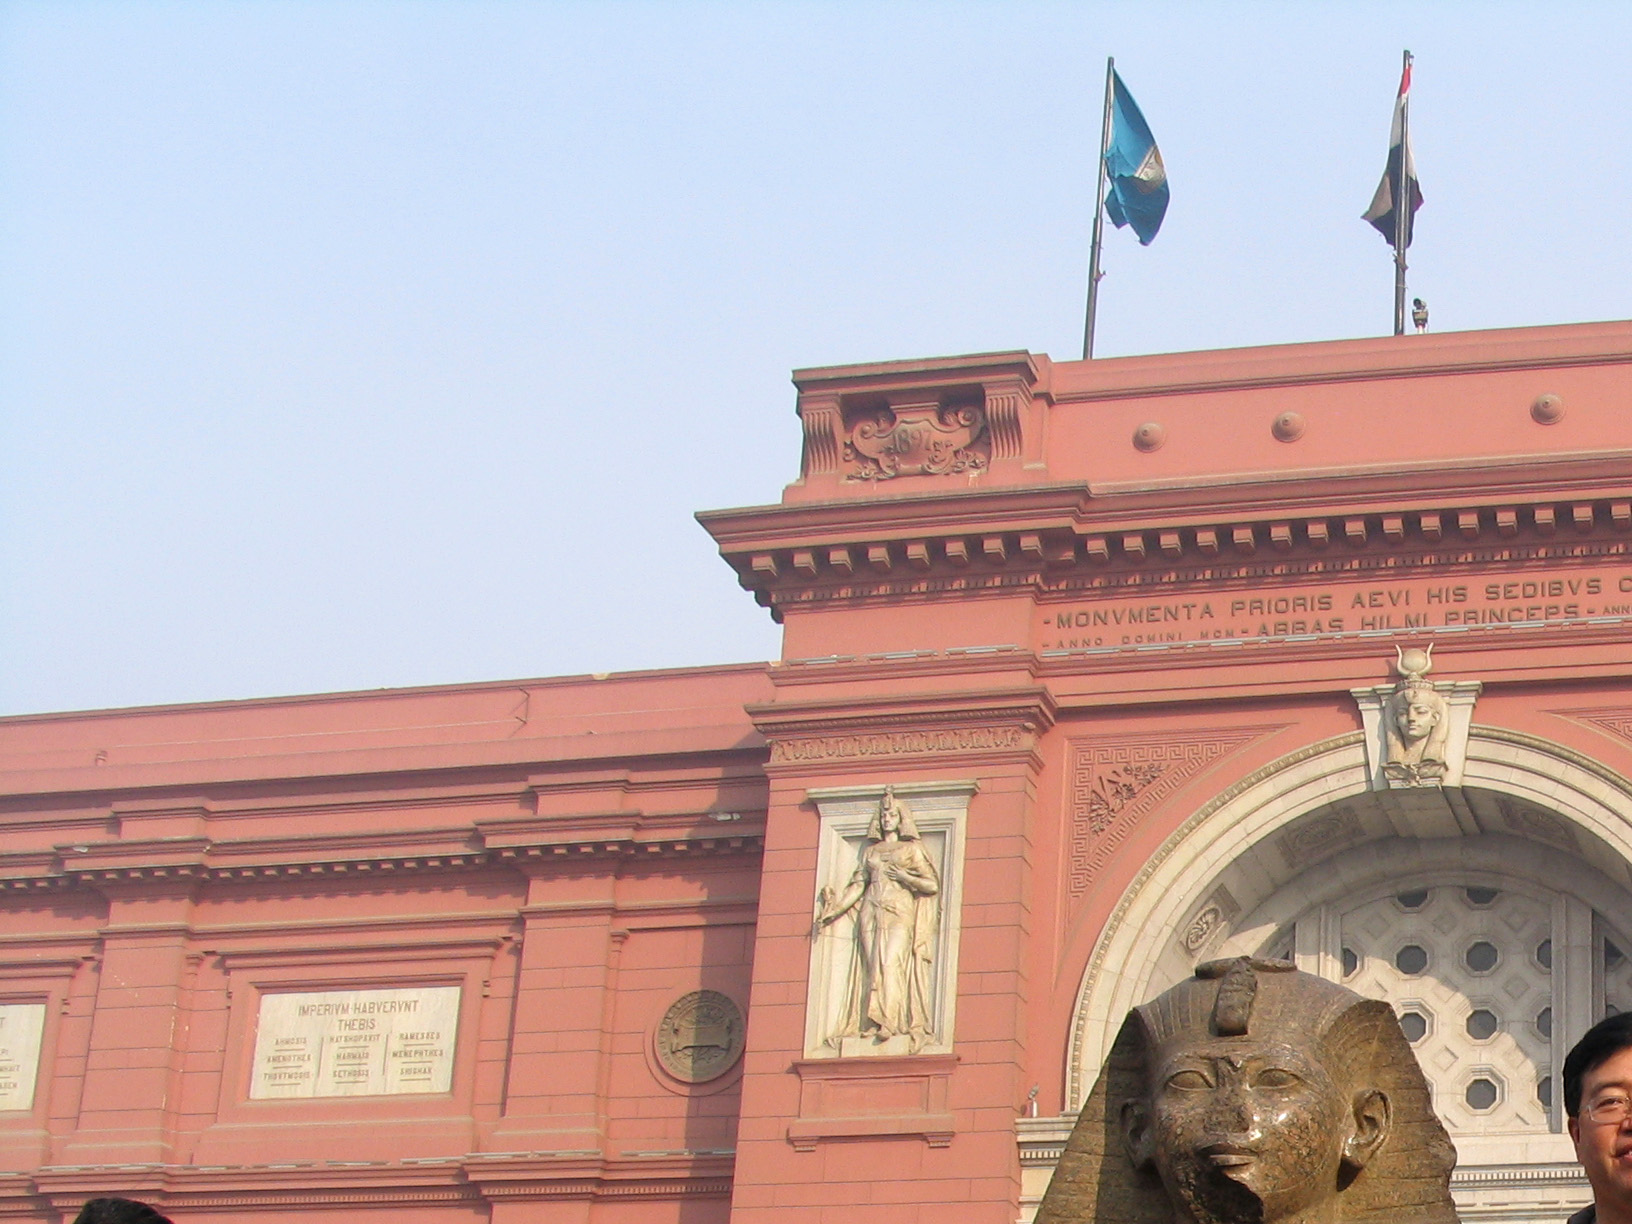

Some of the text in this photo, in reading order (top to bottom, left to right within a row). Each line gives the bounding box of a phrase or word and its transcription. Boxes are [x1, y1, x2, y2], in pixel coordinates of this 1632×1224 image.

[1056, 602, 1214, 629] MONVMENTA
[1231, 594, 1333, 617] PRIORIS
[1351, 589, 1410, 609] AEVI
[1427, 584, 1468, 605] HIS
[1485, 577, 1602, 601] SEDIBVS
[1057, 637, 1103, 648] ANNO
[1121, 631, 1182, 645] DOMINI
[1200, 628, 1235, 640] MCM
[1257, 617, 1344, 637] ABBAS
[1361, 612, 1428, 631] HILMI
[1445, 603, 1579, 626] PRINCEPS
[299, 1000, 419, 1017] IMPERIVM HABVERVNT
[338, 1018, 376, 1031] THEBIS
